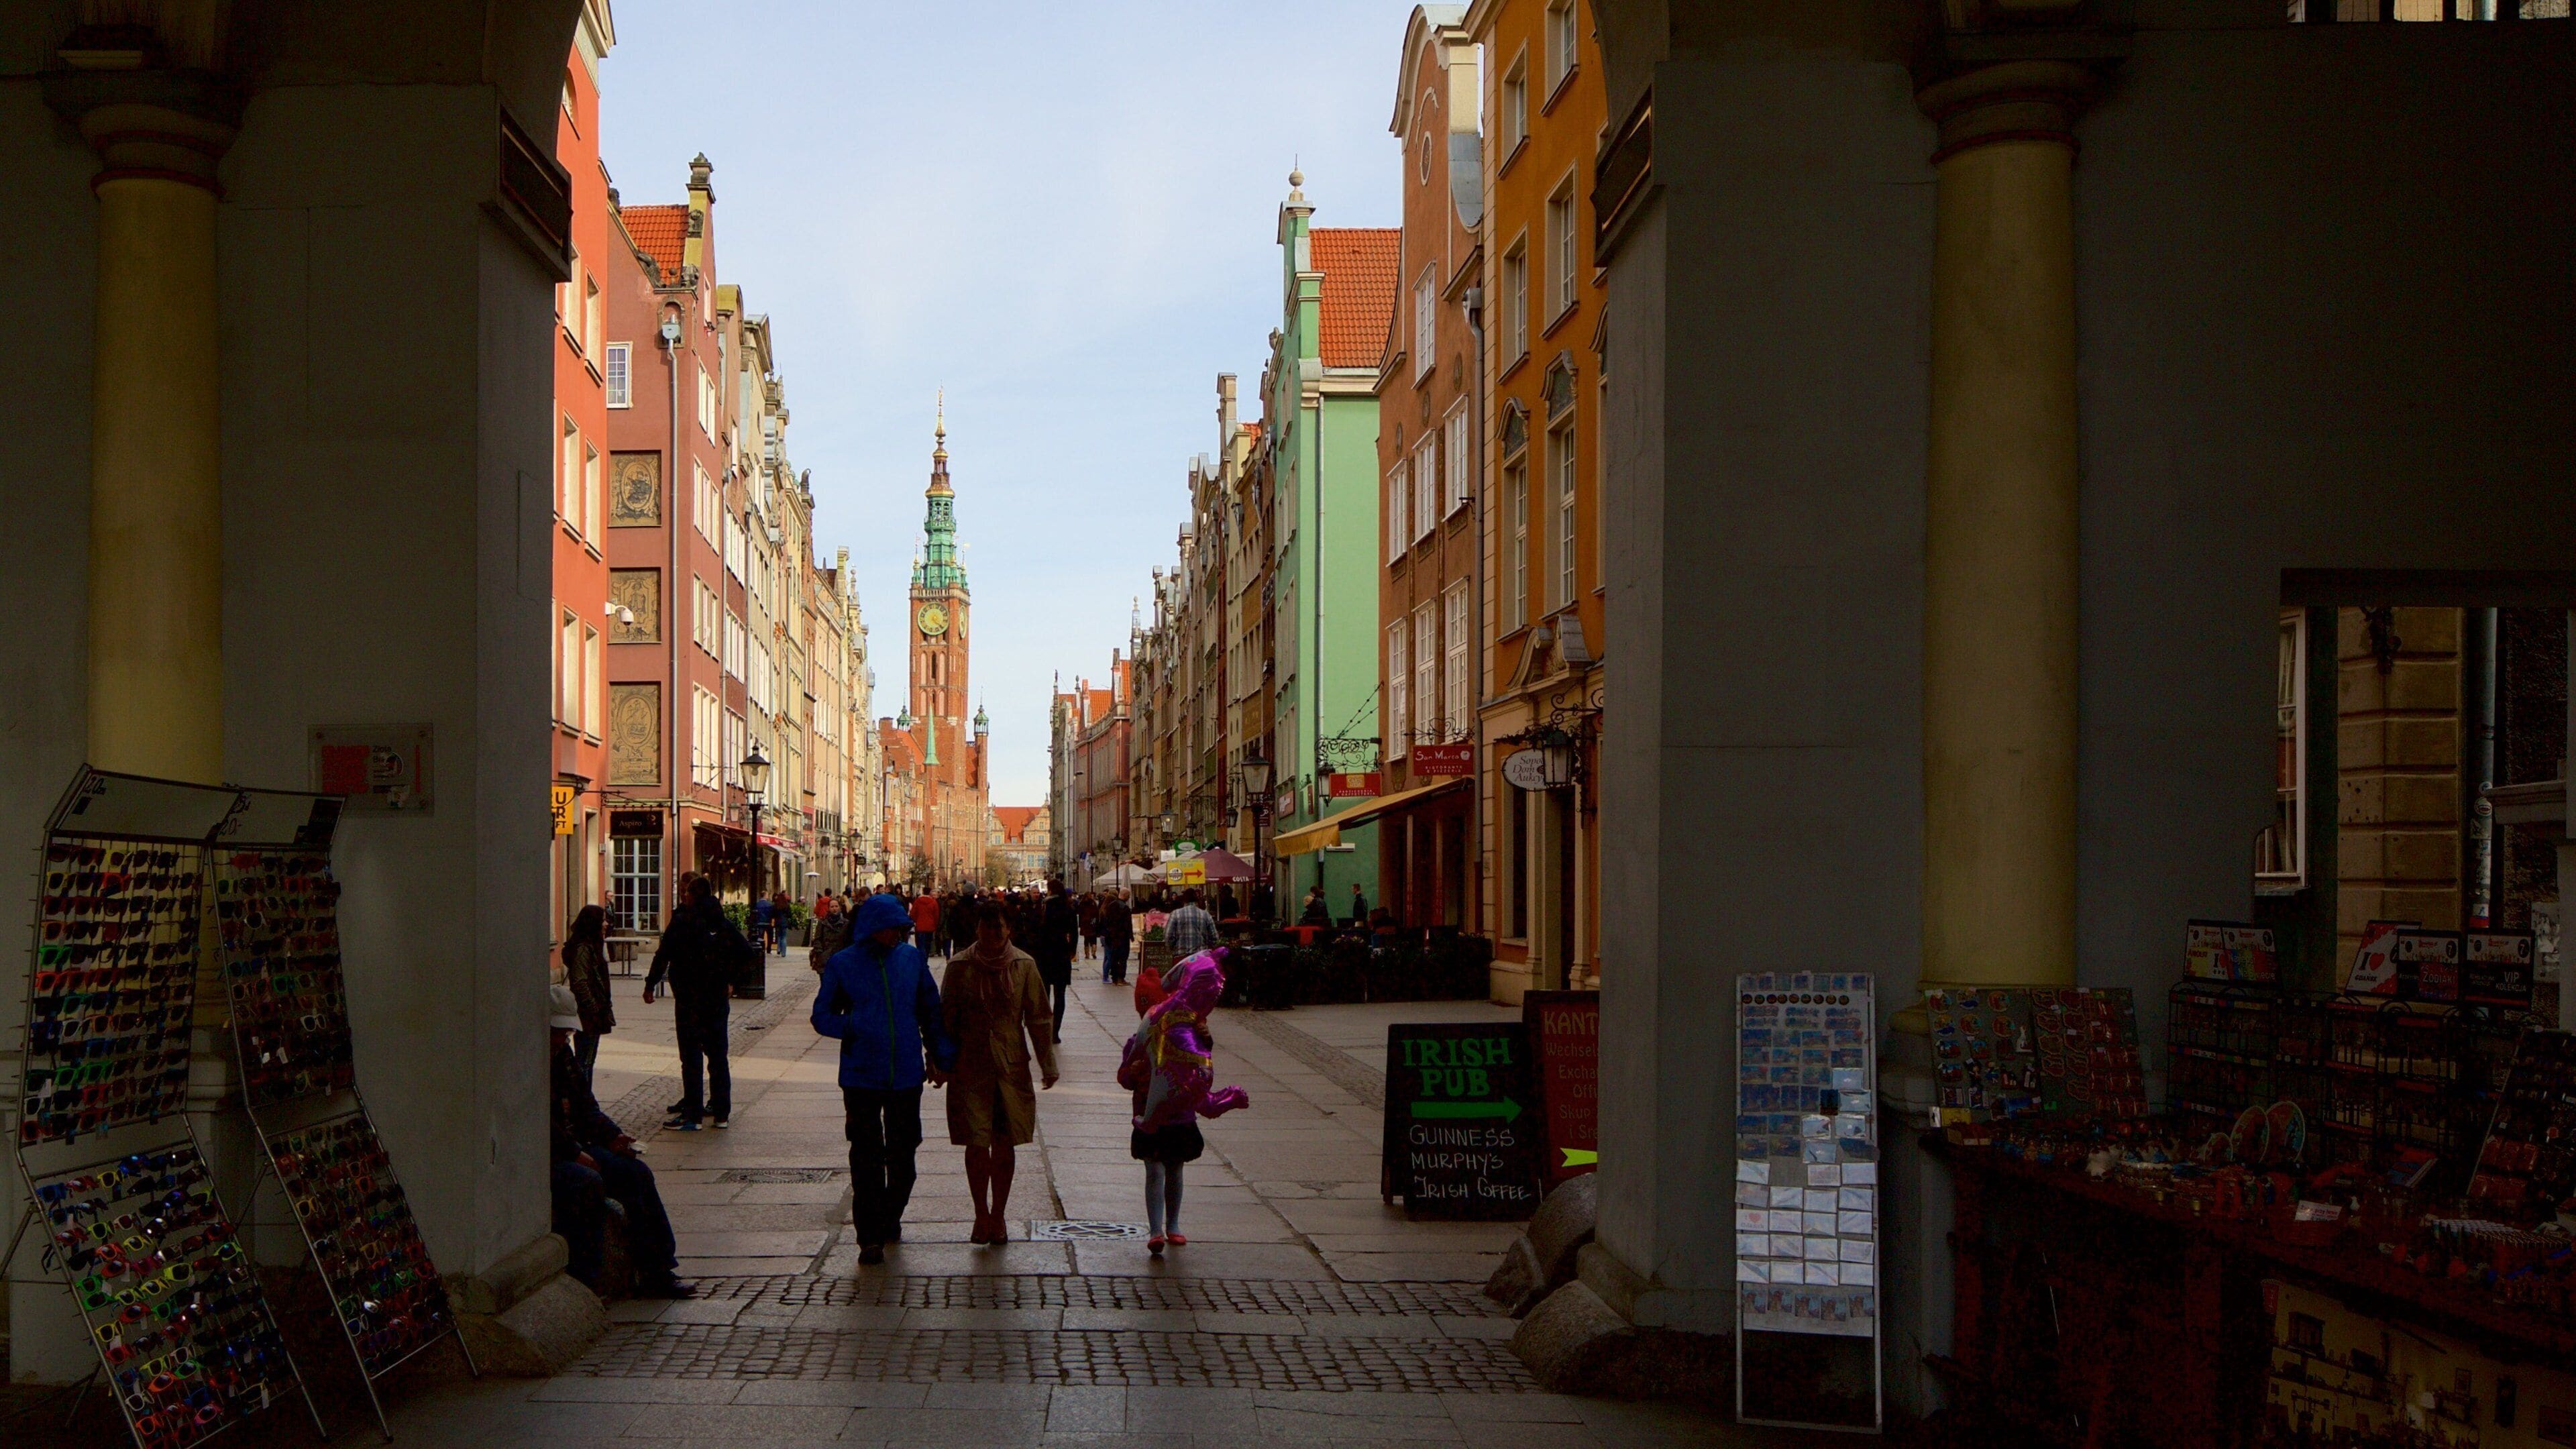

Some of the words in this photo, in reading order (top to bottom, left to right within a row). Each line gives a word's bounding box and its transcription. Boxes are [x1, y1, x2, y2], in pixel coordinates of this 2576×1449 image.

[1415, 751, 1433, 761] San
[1434, 749, 1460, 760] Marco
[1513, 764, 1535, 773] Dom
[618, 820, 643, 828] Aspiro
[2359, 951, 2371, 971] I
[2422, 971, 2456, 983] ZODIAKI
[2504, 971, 2520, 983] VIP
[1544, 1010, 1599, 1035] KANT
[1401, 1038, 1511, 1067] IRISH
[1546, 1041, 1599, 1057] Wechsel
[1558, 1065, 1599, 1079] Excha
[1419, 1069, 1491, 1097] PUB
[1558, 1104, 1591, 1120] Skup
[1409, 1124, 1515, 1147] GUINNESS
